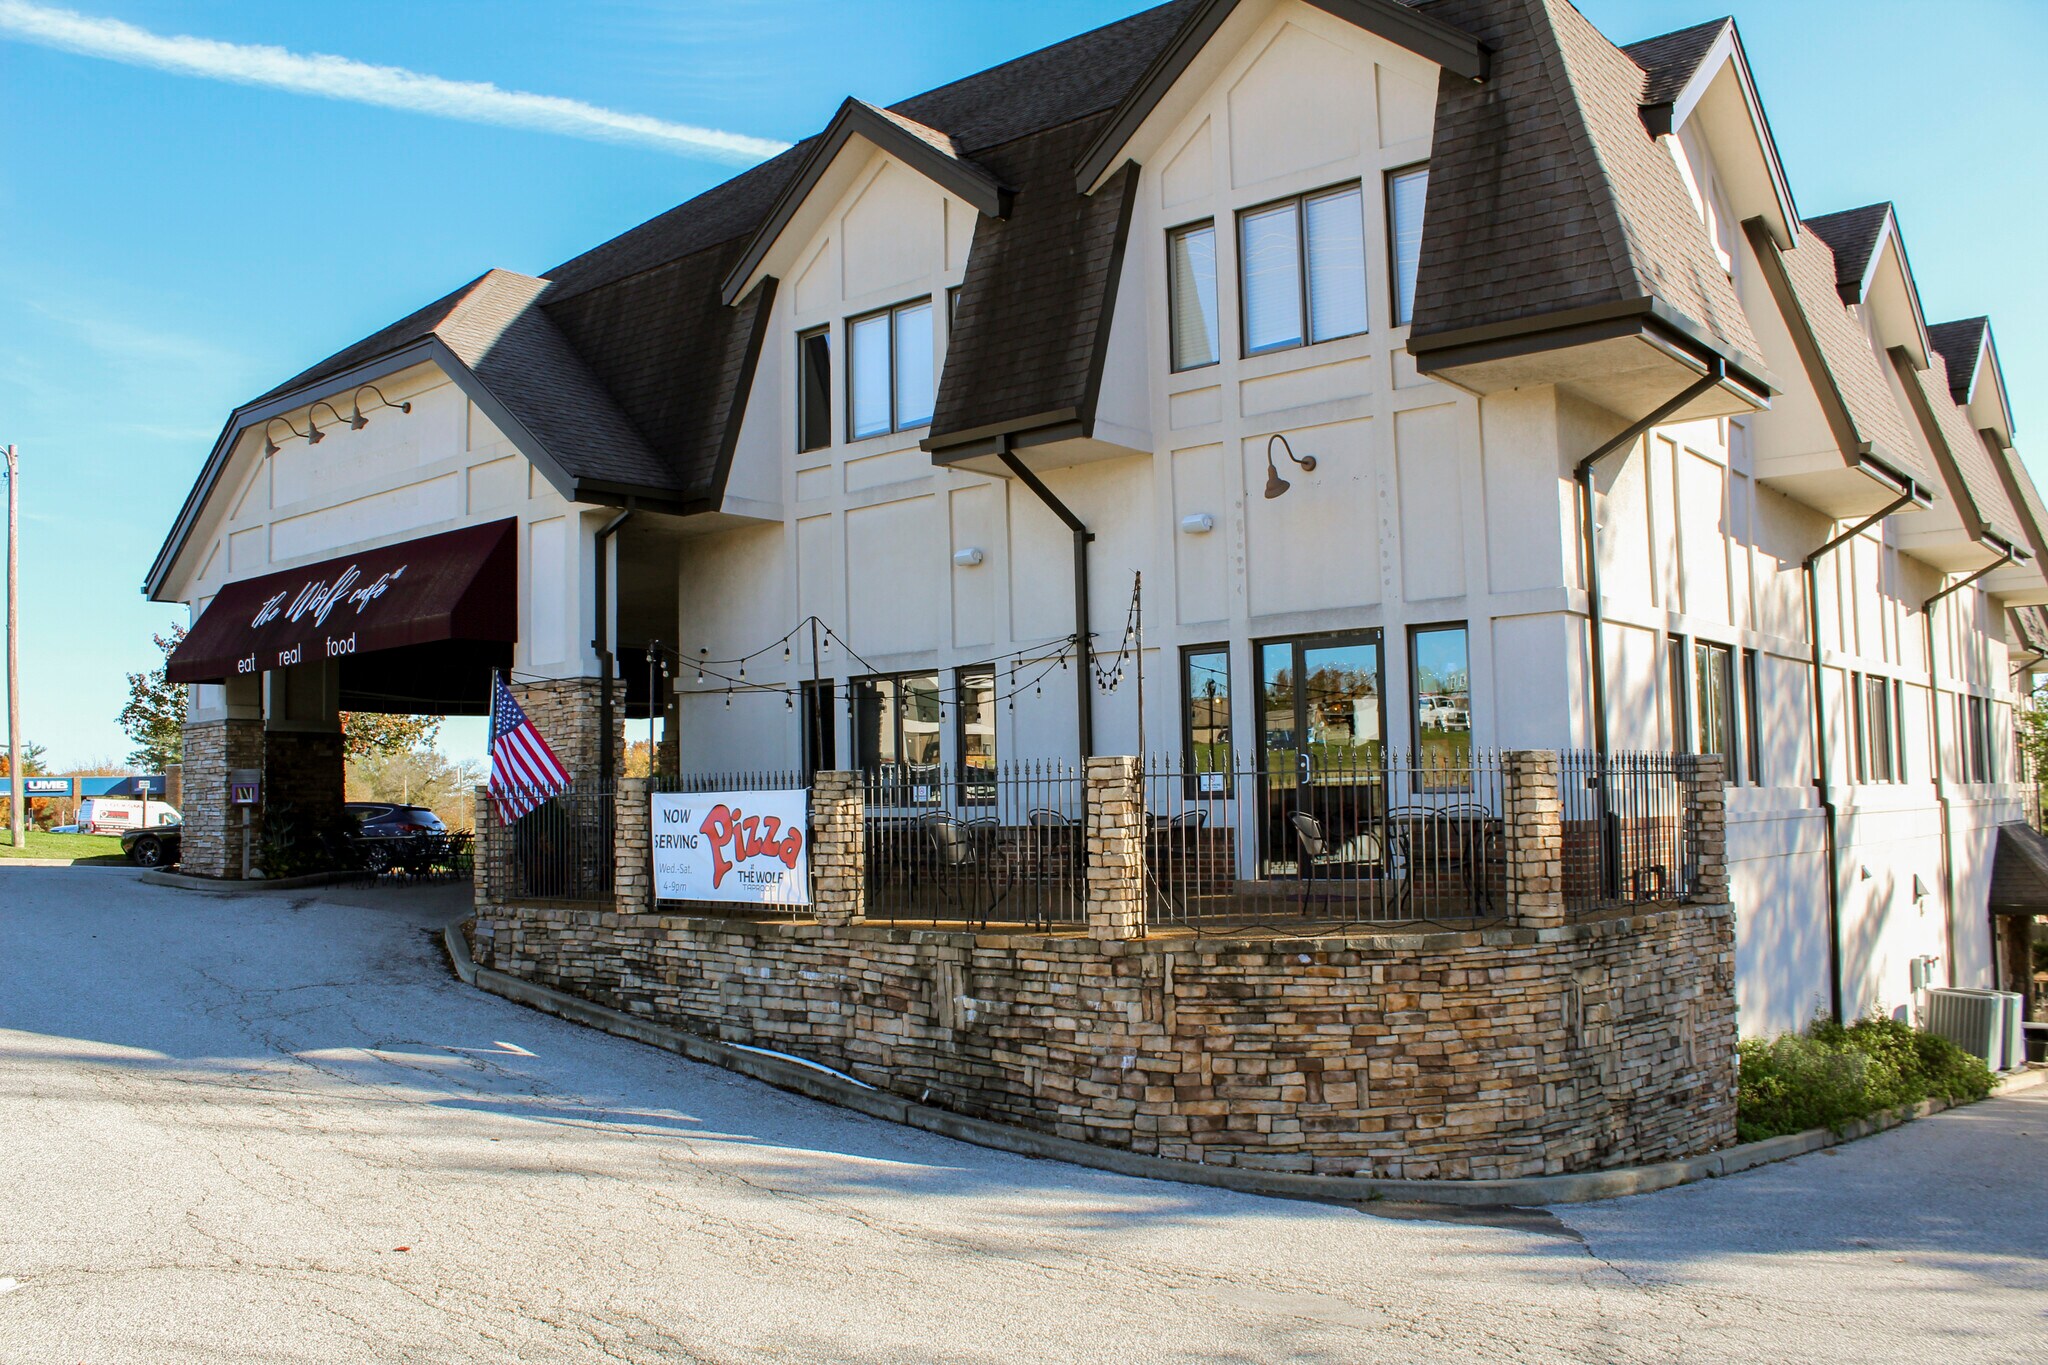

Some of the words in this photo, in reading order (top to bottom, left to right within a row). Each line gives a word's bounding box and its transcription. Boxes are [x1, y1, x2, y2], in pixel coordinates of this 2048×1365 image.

[251, 591, 287, 629] the
[285, 564, 361, 628] Wolf
[237, 652, 256, 674] eat
[278, 643, 301, 667] real
[326, 632, 356, 657] food
[28, 780, 68, 789] UMB
[663, 808, 691, 824] NOW
[655, 834, 698, 849] SERVING
[700, 804, 803, 890] Pizza
[659, 863, 693, 875] Wed.-Sat.
[737, 871, 755, 883] THE
[756, 871, 784, 884] WOLF
[663, 882, 687, 893] 4-9pm
[742, 884, 776, 892] TAPROOM
